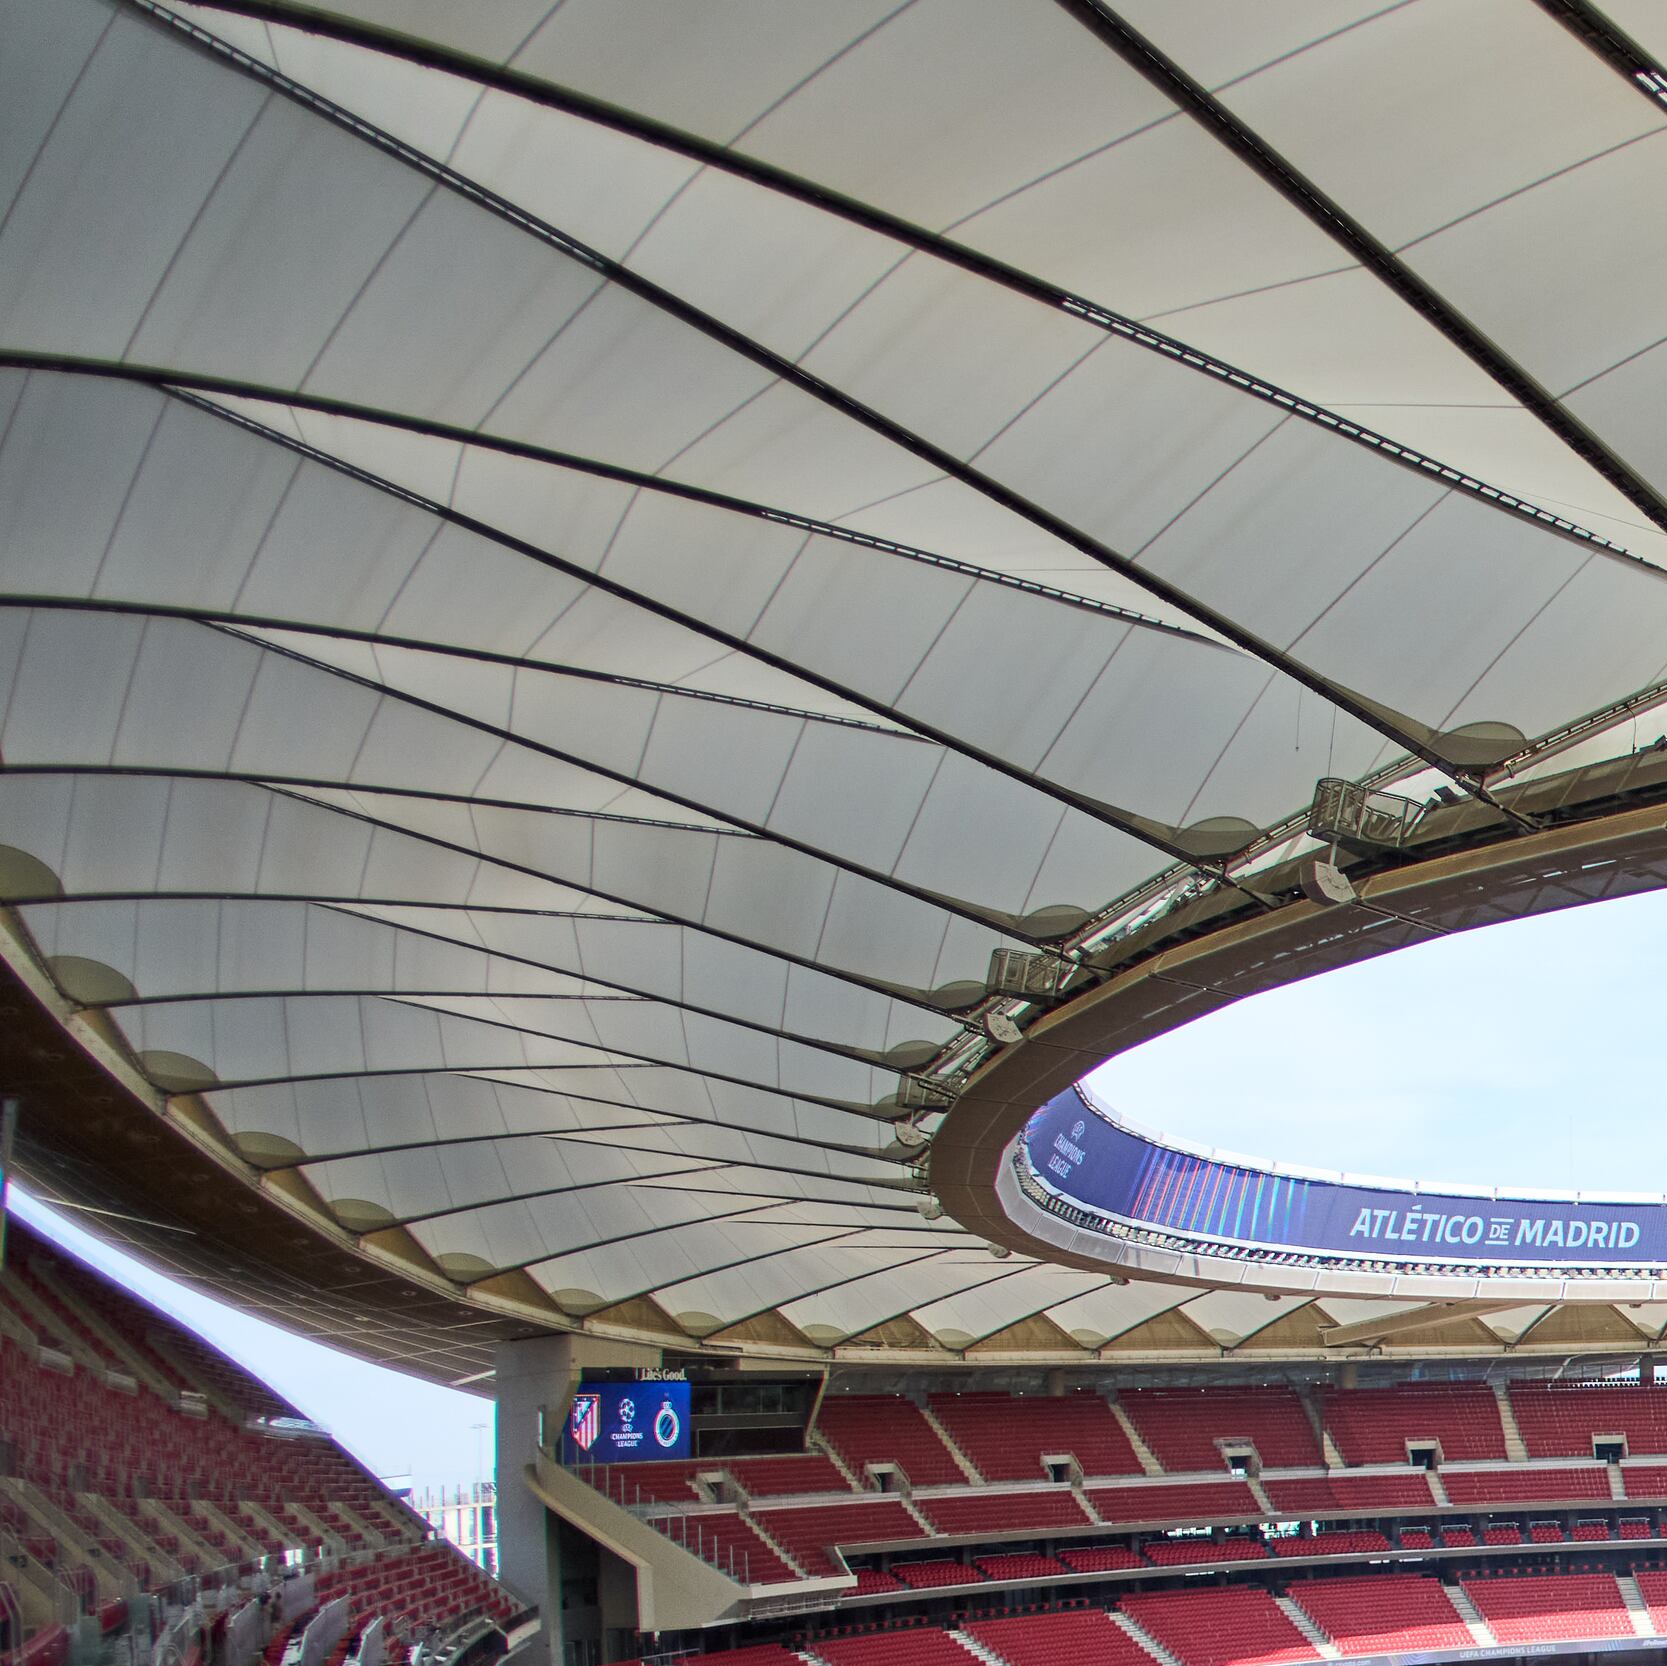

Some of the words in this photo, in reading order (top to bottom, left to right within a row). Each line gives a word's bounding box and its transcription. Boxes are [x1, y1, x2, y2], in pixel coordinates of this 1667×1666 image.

[1054, 1133, 1086, 1165] CHAMPIONS
[1048, 1154, 1072, 1179] LEAGUE
[1350, 1205, 1484, 1244] ATLÉTICO
[1489, 1223, 1509, 1239] DE
[1514, 1219, 1640, 1248] MADRID
[611, 1433, 643, 1441] CHAMPIONS
[1459, 1650, 1479, 1658] UEFA
[1480, 1646, 1526, 1657] CHAMPIONS
[1527, 1644, 1556, 1653] LEAGUE
